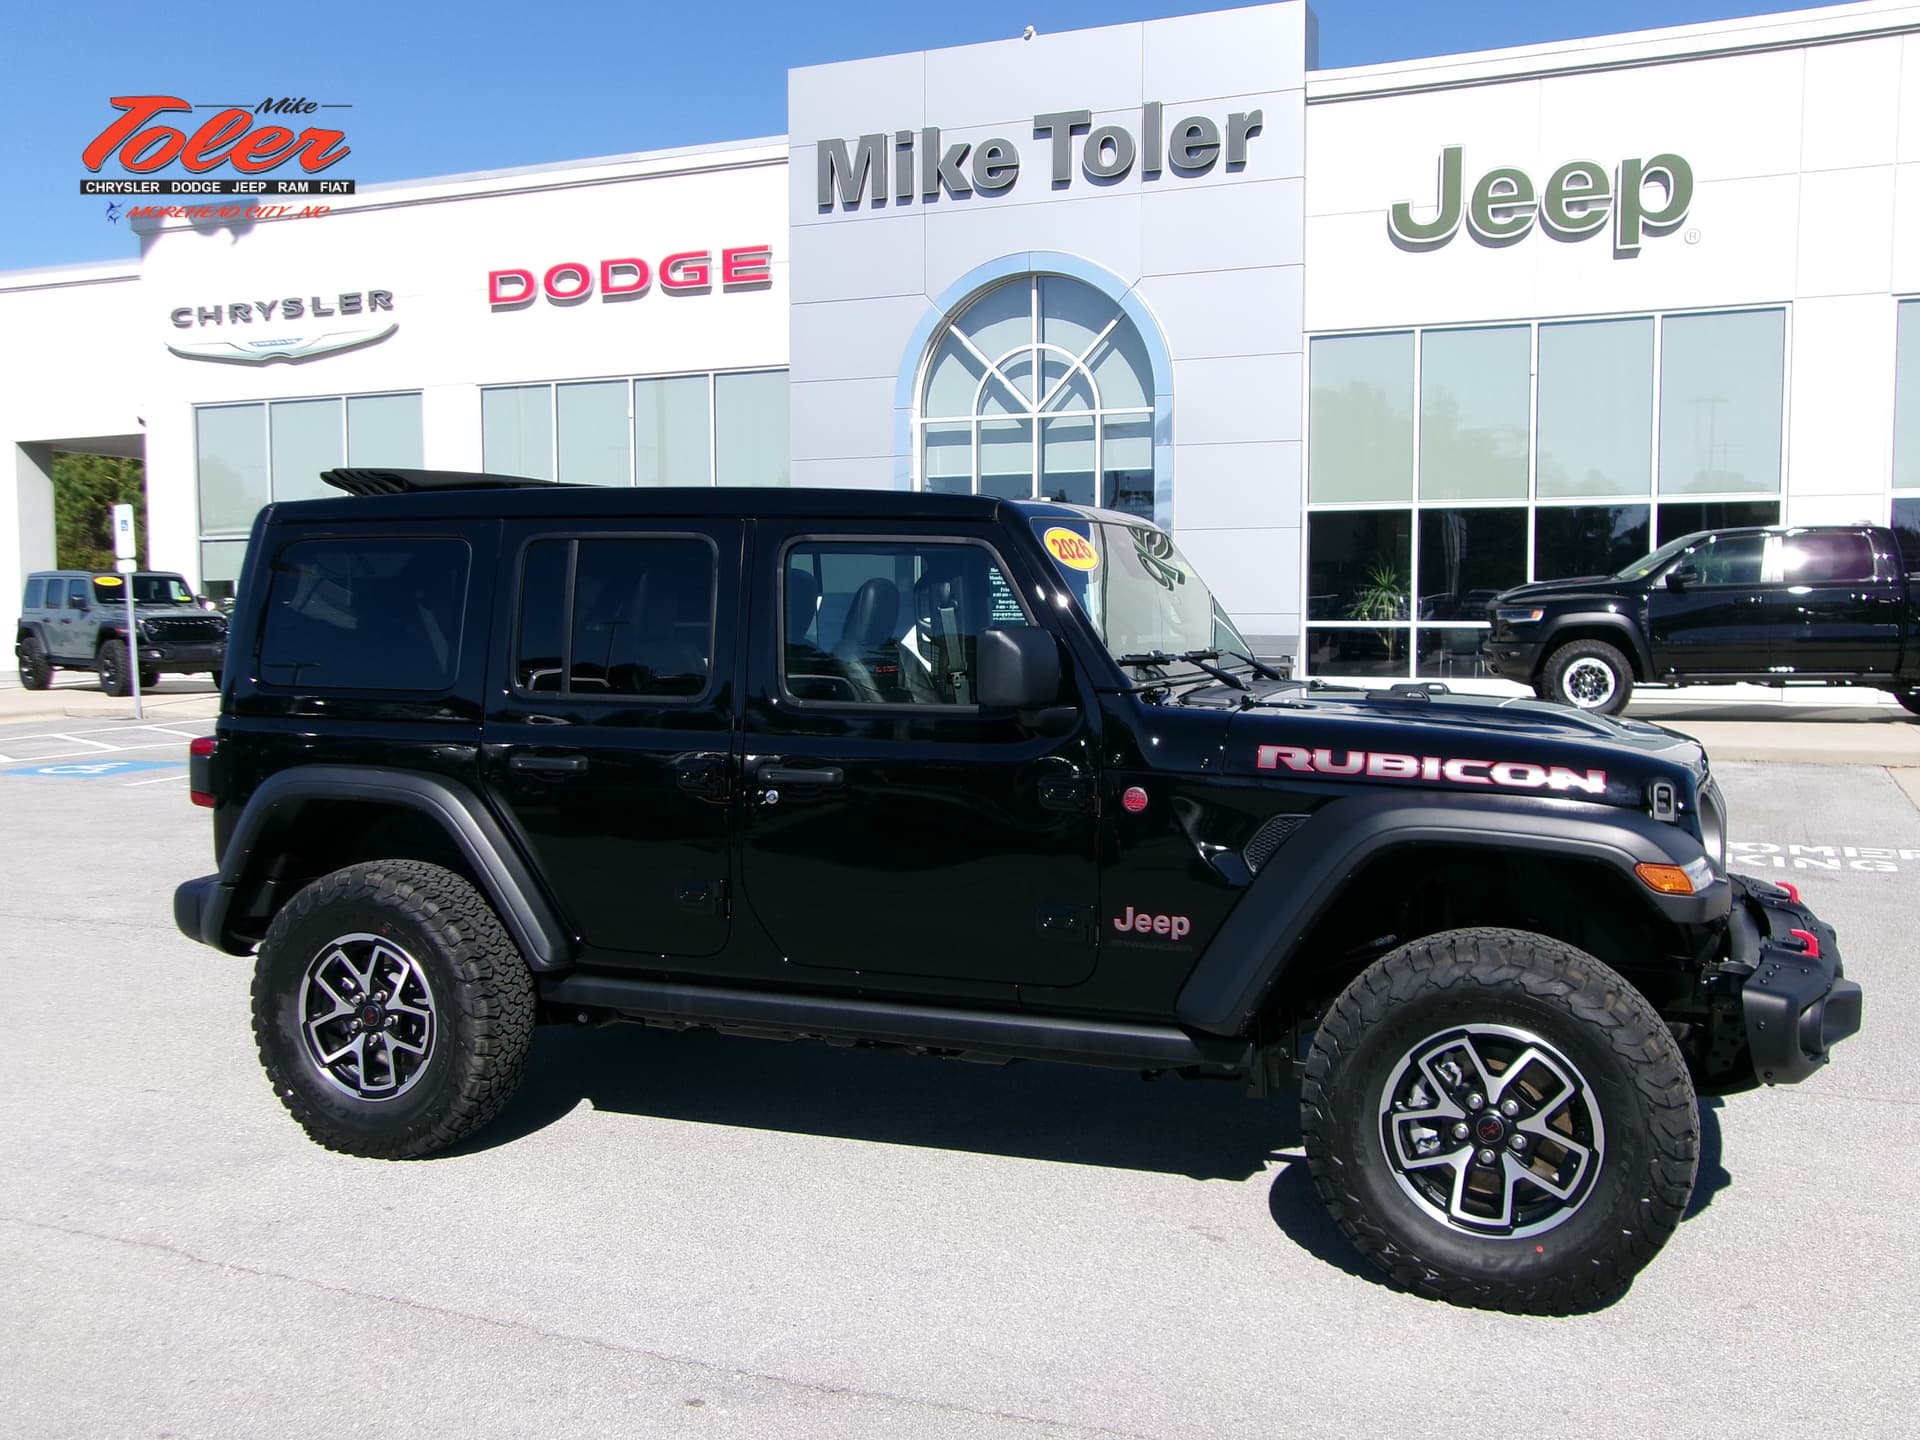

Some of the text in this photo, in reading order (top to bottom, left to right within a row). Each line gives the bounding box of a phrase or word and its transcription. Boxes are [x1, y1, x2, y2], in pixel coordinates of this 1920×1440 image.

[816, 100, 1264, 213] Mike Toler
[1387, 144, 1694, 259] Jeep
[488, 244, 774, 313] DODGE
[170, 289, 395, 328] CHRYSLER
[1052, 538, 1092, 561] 2026
[1257, 744, 1608, 794] RUBICON
[1113, 906, 1191, 940] Jeep
